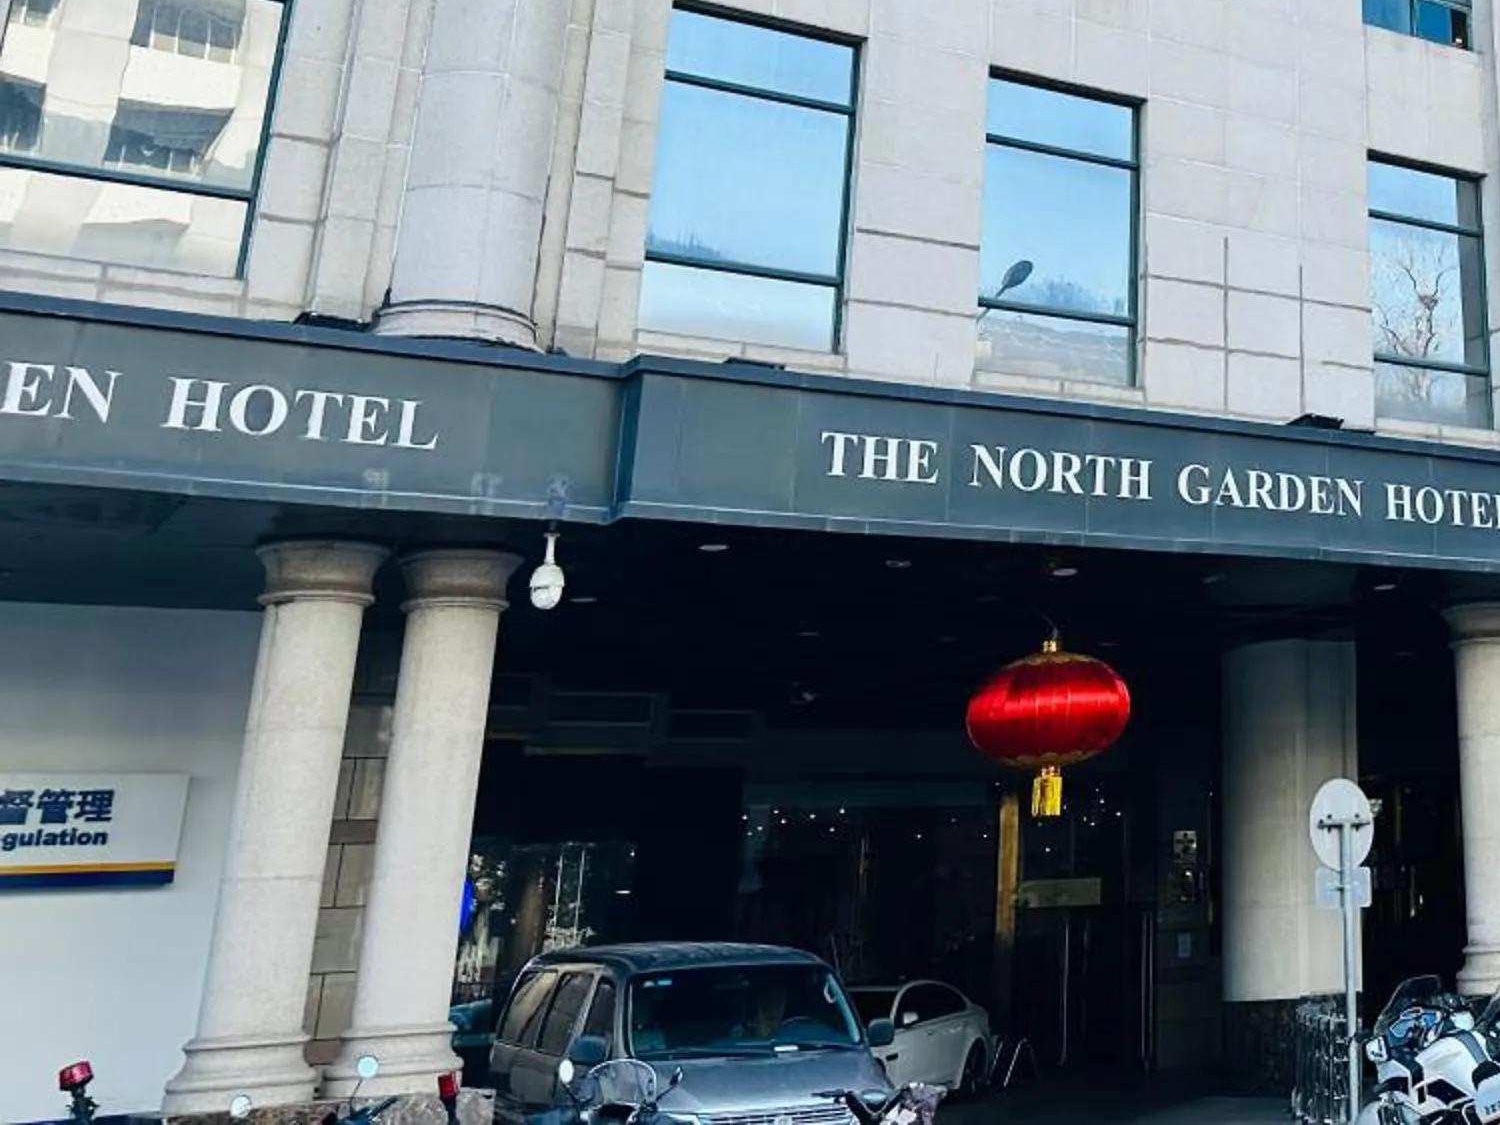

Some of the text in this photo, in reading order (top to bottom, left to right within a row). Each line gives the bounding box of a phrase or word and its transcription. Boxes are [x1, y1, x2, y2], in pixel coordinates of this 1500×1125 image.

[0, 361, 439, 451] EN HOTEL
[821, 431, 939, 485] THE
[969, 444, 1152, 500] NORTH
[1177, 463, 1363, 517] GARDEN
[2, 827, 108, 851] gulation
